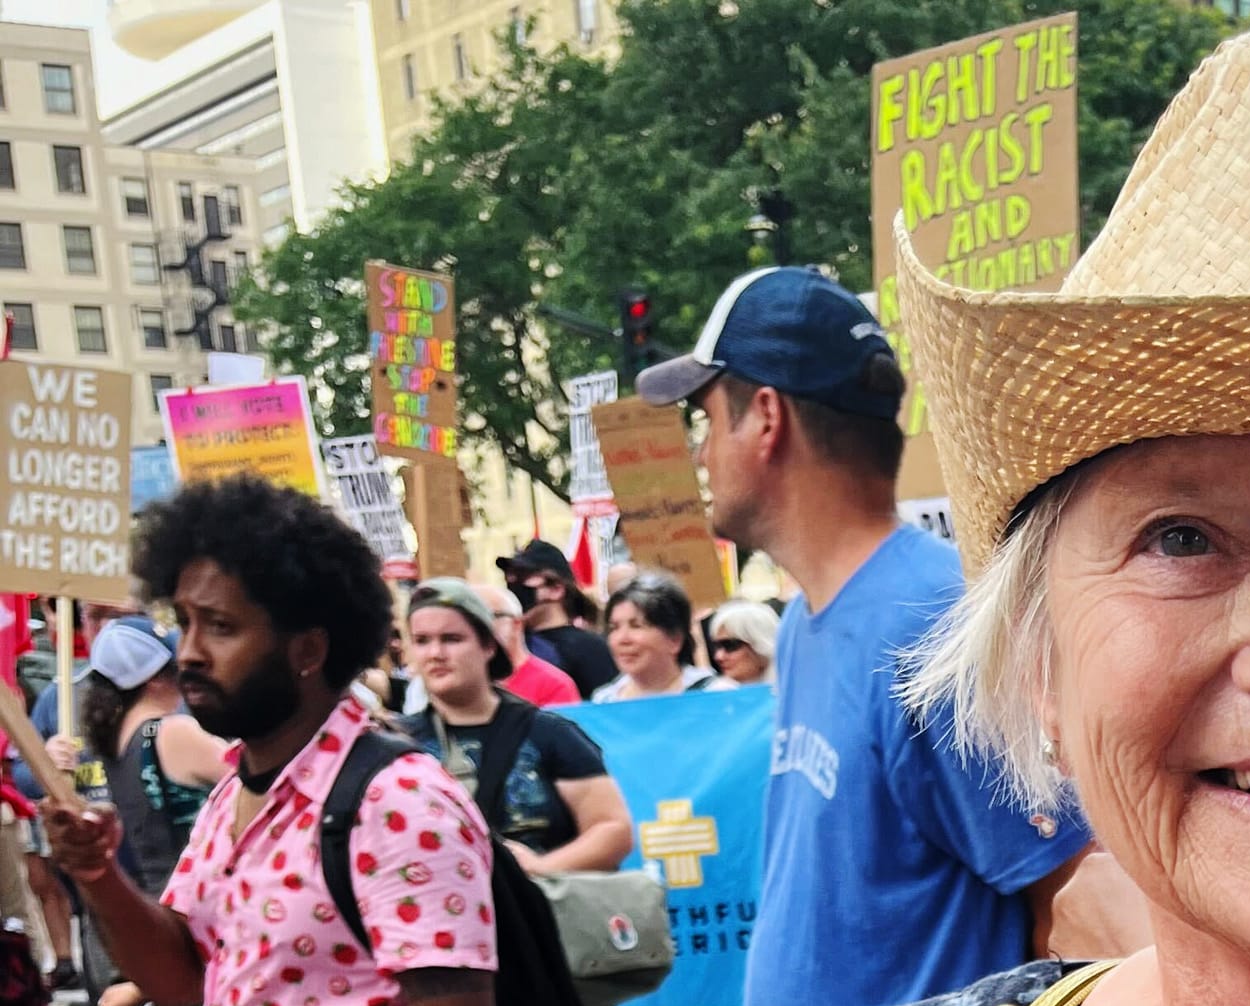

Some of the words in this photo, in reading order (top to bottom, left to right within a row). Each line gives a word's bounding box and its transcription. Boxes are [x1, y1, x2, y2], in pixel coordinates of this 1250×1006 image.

[877, 38, 1002, 152] FIGHT
[1014, 24, 1075, 103] THE
[900, 103, 1052, 233] RACIST
[946, 195, 1031, 262] AND
[379, 270, 448, 314] STAND
[384, 310, 434, 337] WITH
[369, 330, 456, 373] PALESTINE
[27, 364, 98, 408] WE
[386, 363, 436, 393] STOP
[9, 402, 70, 444] CAN
[76, 411, 120, 449] NO
[393, 391, 429, 418] THE
[374, 411, 457, 458] GENOCIDE
[8, 448, 121, 493] LONGER
[8, 491, 120, 535] AFFORD
[0, 529, 54, 571] THE
[60, 537, 129, 577] RICH
